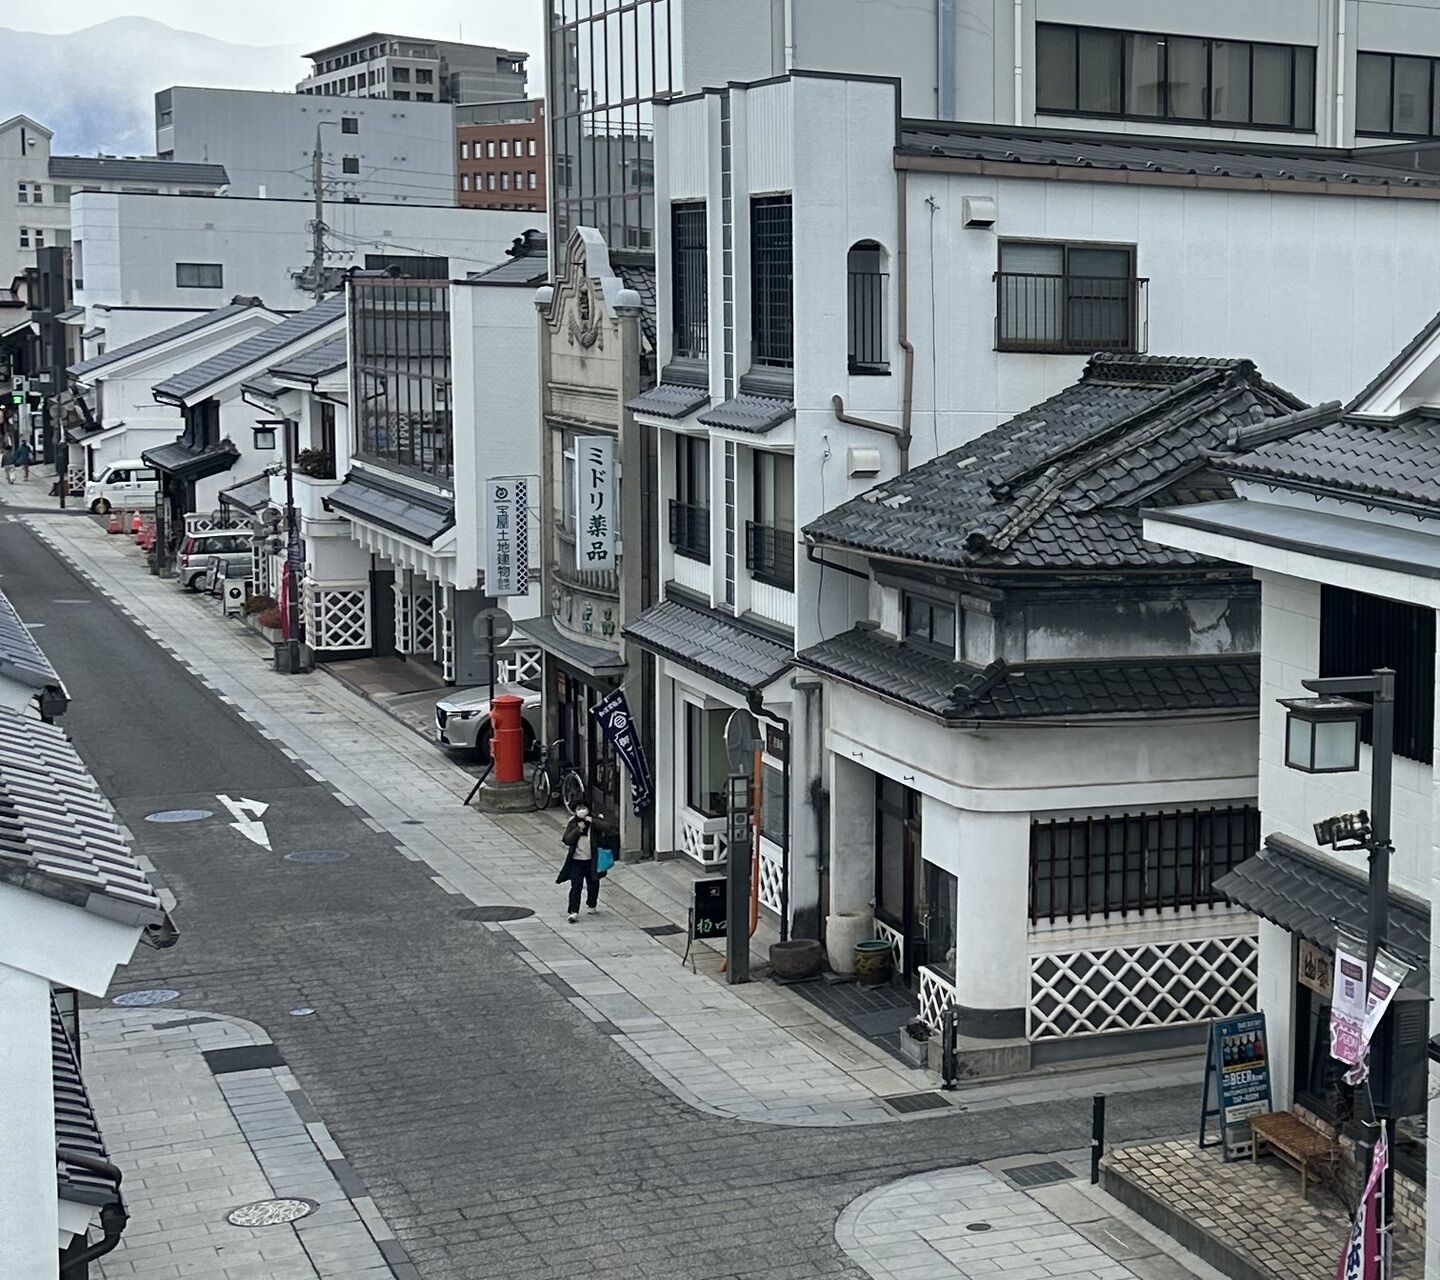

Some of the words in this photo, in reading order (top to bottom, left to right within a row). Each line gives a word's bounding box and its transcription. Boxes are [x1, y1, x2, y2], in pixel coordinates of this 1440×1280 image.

[13, 377, 22, 390] P
[586, 446, 609, 562] ミドリ薬品
[1230, 1070, 1252, 1086] BEER
